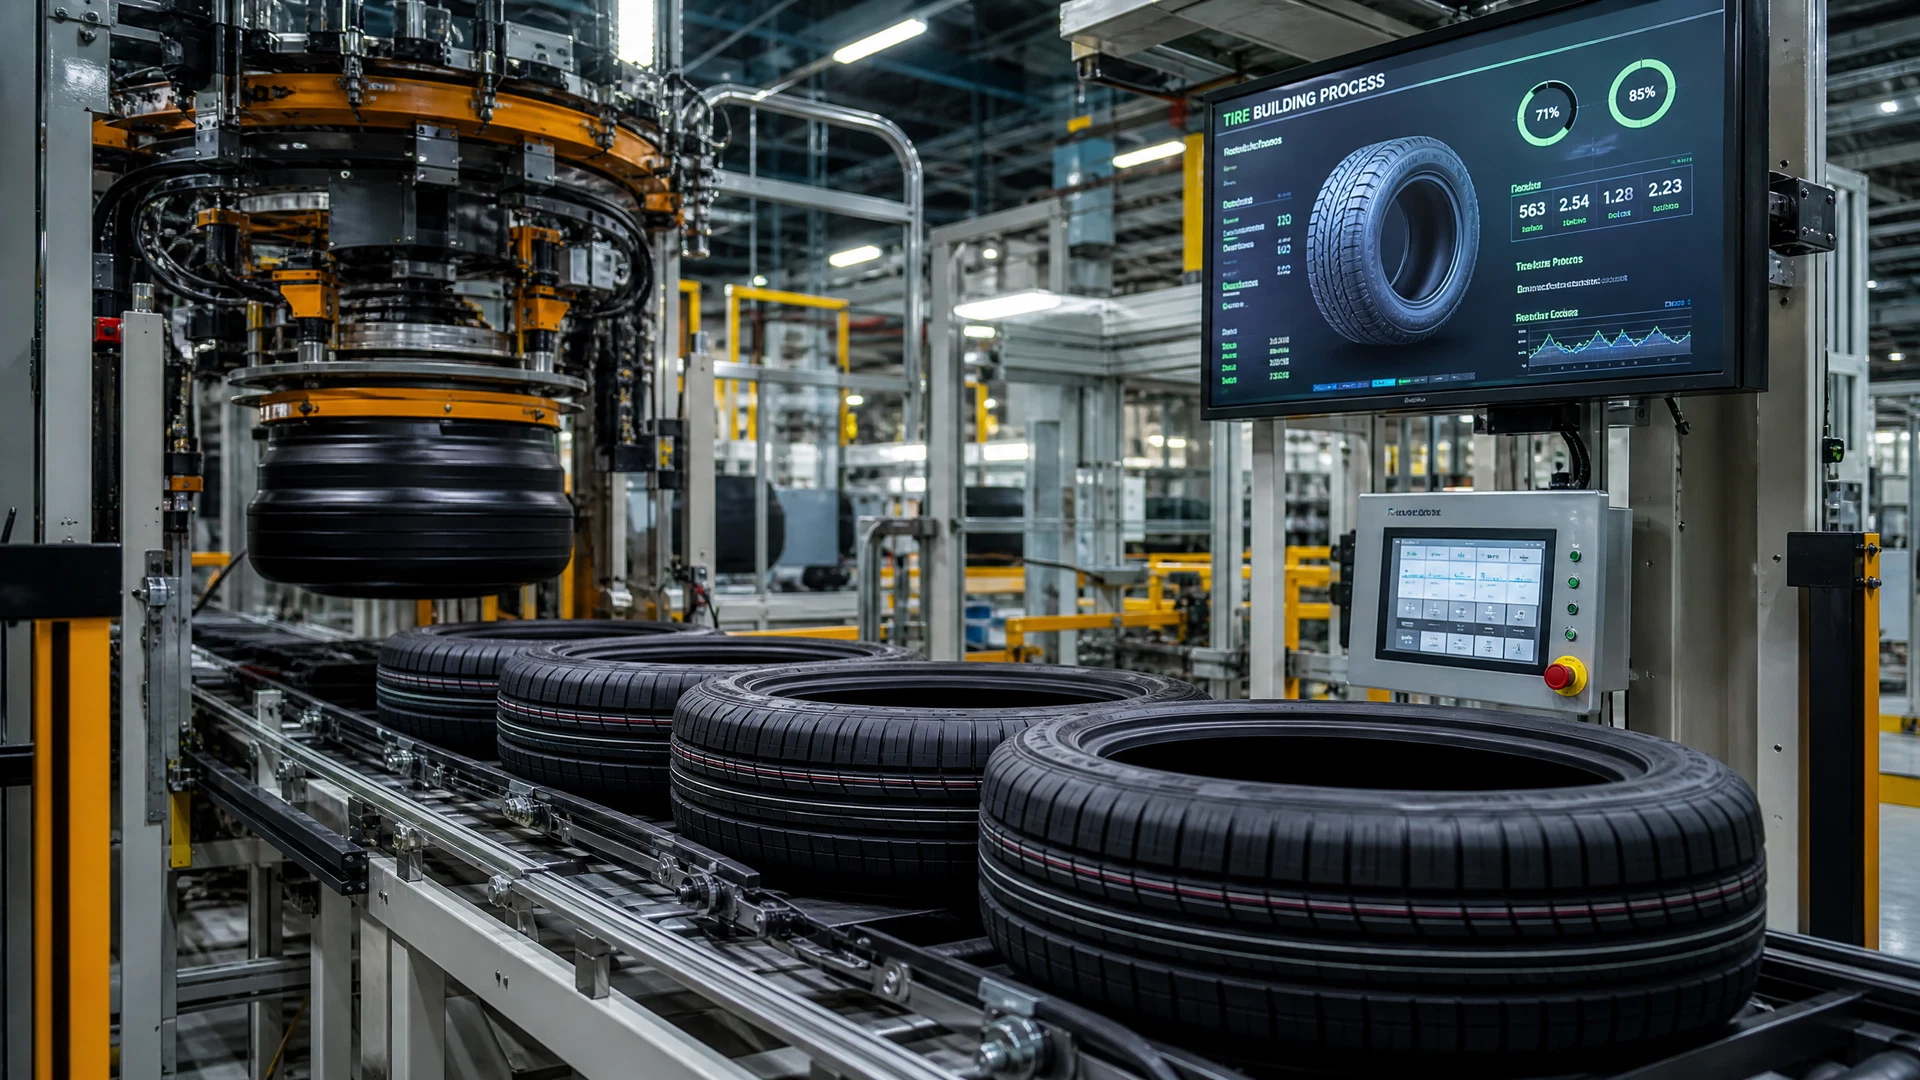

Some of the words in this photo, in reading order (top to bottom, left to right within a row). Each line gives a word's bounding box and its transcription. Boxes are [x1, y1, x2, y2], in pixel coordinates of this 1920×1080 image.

[1223, 107, 1250, 127] TIRE
[1253, 91, 1316, 120] BUILDING
[1320, 72, 1386, 103] PROCESS
[1628, 85, 1656, 102] 85%
[1535, 106, 1560, 121] 71%
[1519, 201, 1546, 219] 563
[1559, 193, 1590, 213] 2.54
[1603, 187, 1634, 206] 1.28
[1648, 178, 1683, 198] 2.23
